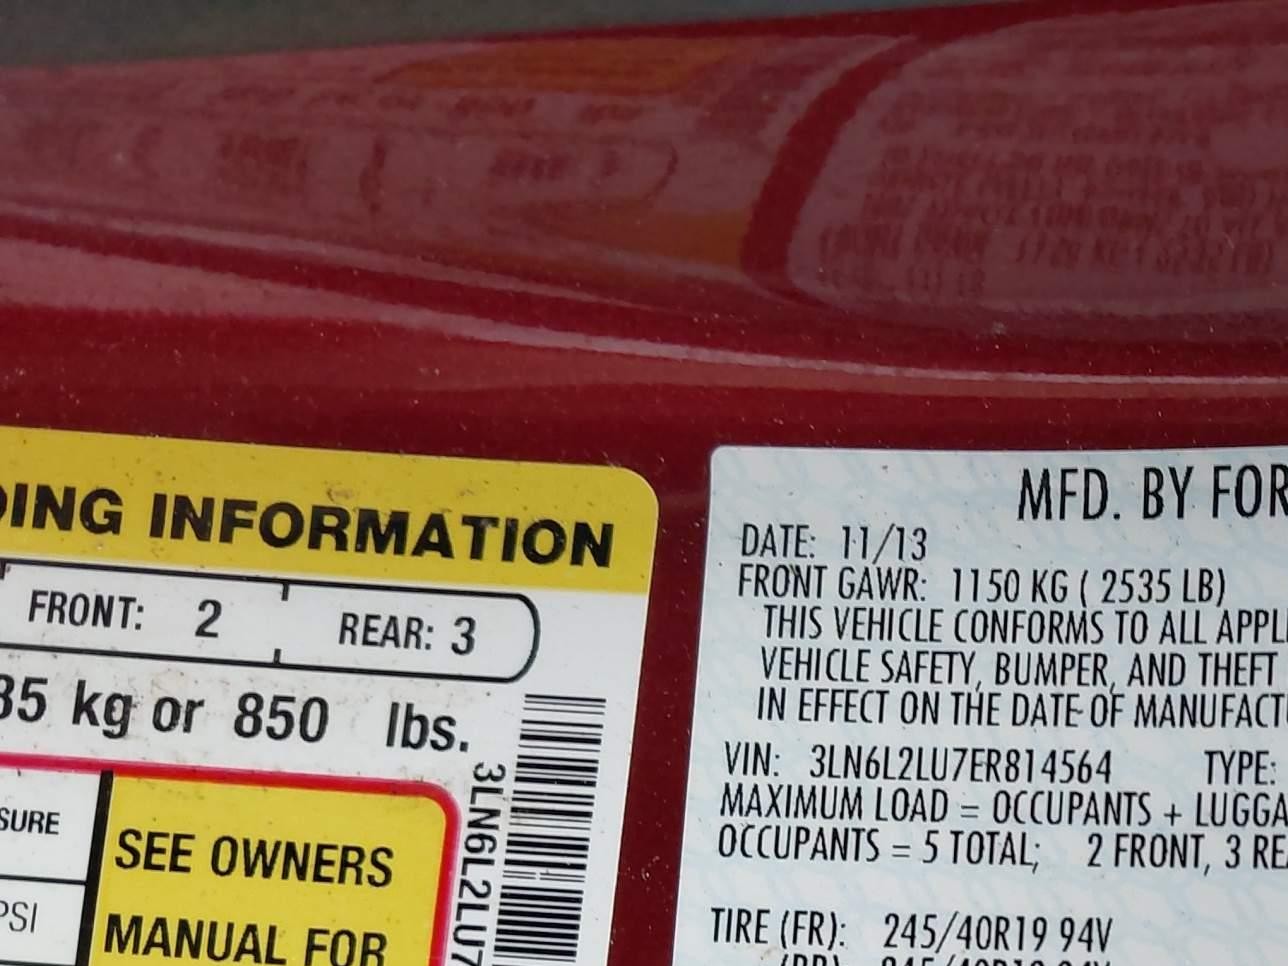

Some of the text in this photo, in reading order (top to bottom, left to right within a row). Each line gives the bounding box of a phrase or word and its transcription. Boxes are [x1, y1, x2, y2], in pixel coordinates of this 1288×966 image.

[1017, 468, 1120, 521] MFD.
[1143, 466, 1194, 520] BY
[0, 483, 614, 568] ING INFORMATION
[742, 523, 927, 565] DATE: 11/13
[739, 563, 828, 598] FRONT
[839, 566, 926, 601] GAWR:
[953, 568, 1019, 603] 1150
[1032, 569, 1068, 603] KG
[1102, 569, 1171, 603] 2535
[1183, 568, 1225, 607] LB)
[29, 590, 221, 638] FRONT: 2
[339, 612, 475, 655] REAR: 3
[764, 604, 822, 639] THIS
[834, 606, 944, 642] VEHICLE
[954, 609, 1104, 644] CONFORMS
[1115, 610, 1148, 644] TO
[1159, 610, 1207, 644] ALL
[761, 646, 871, 682] VEHICLE
[881, 650, 981, 692] SAFETY,
[995, 652, 1115, 688] BUMPER,
[1127, 652, 1186, 687] AND
[1198, 652, 1278, 687] THEFT
[72, 679, 136, 739] kg
[152, 697, 205, 733] or
[234, 692, 328, 743] 850
[386, 702, 468, 752] lbs.
[758, 687, 786, 721] IN
[799, 688, 890, 723] EFFECT
[901, 691, 940, 725] ON
[951, 692, 1001, 726] THE
[1012, 693, 1083, 727] DATE
[1091, 689, 1125, 728] OF
[725, 741, 779, 776] VIN:
[810, 744, 1111, 784] 3LN6L2LU7ER814564
[1204, 750, 1275, 785] TYPE:
[0, 807, 60, 835] SURE
[720, 782, 862, 820] MAXIMUM
[875, 787, 948, 822] LOAD
[961, 806, 979, 818] =
[993, 790, 1151, 826] OCCUPANTS
[1164, 804, 1182, 826] +
[115, 829, 393, 887] SEE OWNERS
[719, 824, 879, 862] OCCUPANTS
[892, 845, 910, 857] =
[923, 830, 939, 863] 5
[950, 830, 1040, 874] TOTAL;
[1088, 833, 1102, 867] 2
[1114, 833, 1210, 876] FRONT,
[1225, 834, 1241, 869] 3
[104, 913, 286, 965] MANUAL
[711, 908, 1112, 954] TIRE (FR): 245/40R19 94V
